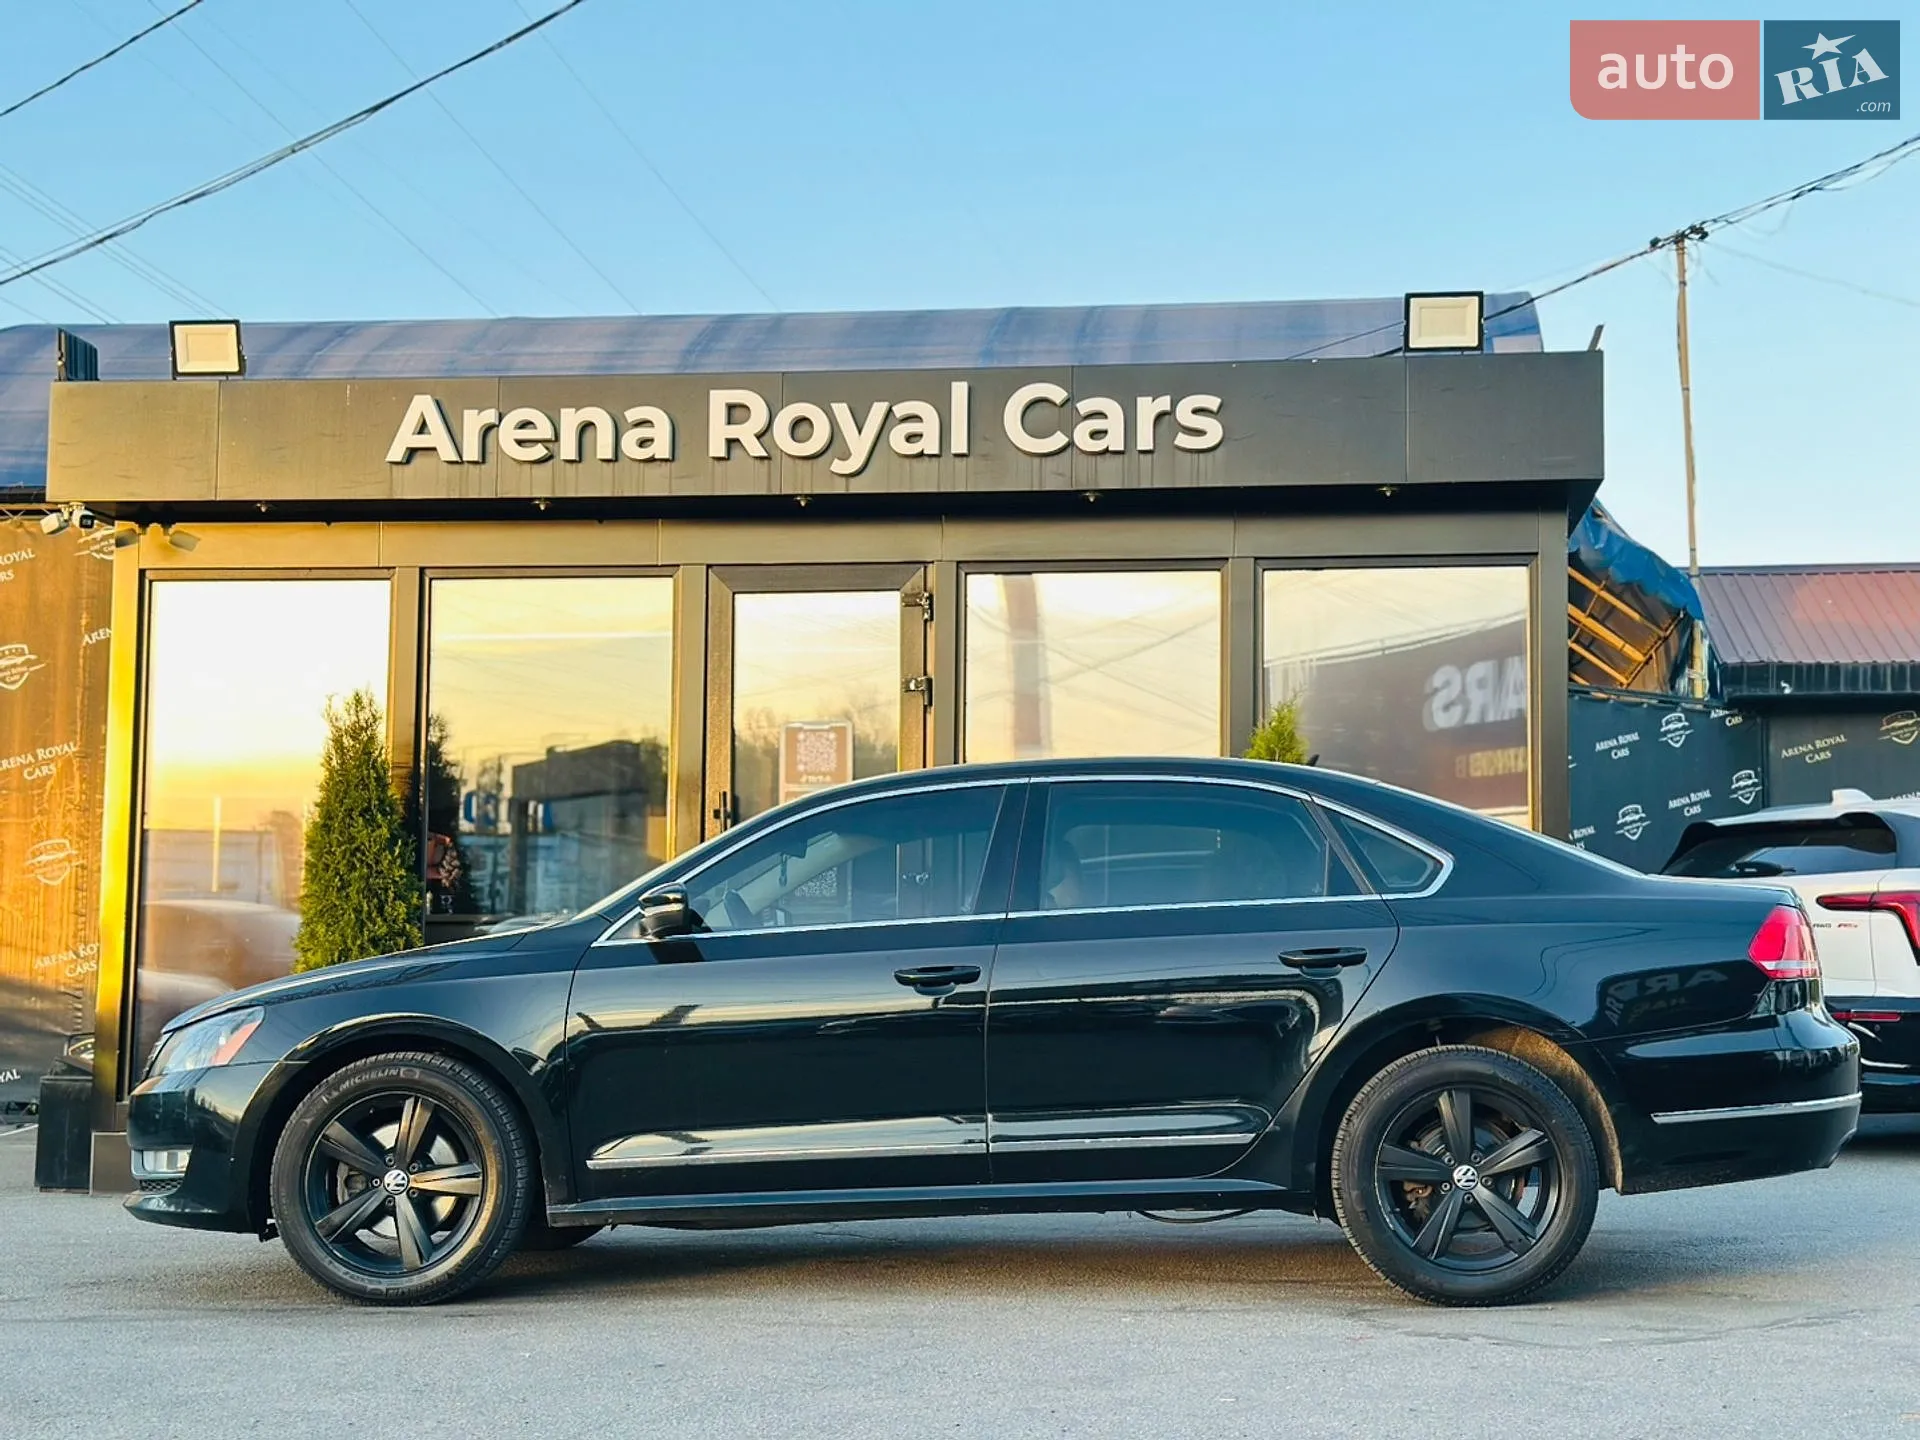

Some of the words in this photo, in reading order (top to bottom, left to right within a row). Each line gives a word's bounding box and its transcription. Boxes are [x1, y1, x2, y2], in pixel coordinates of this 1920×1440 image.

[384, 394, 674, 464] Arena
[708, 381, 970, 477] Royal
[1003, 382, 1225, 456] Cars
[36, 741, 78, 761] ROYAL
[1781, 743, 1814, 758] ARENA
[1814, 733, 1847, 749] ROYAL
[1805, 750, 1832, 763] CARS
[23, 763, 57, 780] CARS
[65, 960, 98, 977] CARS
